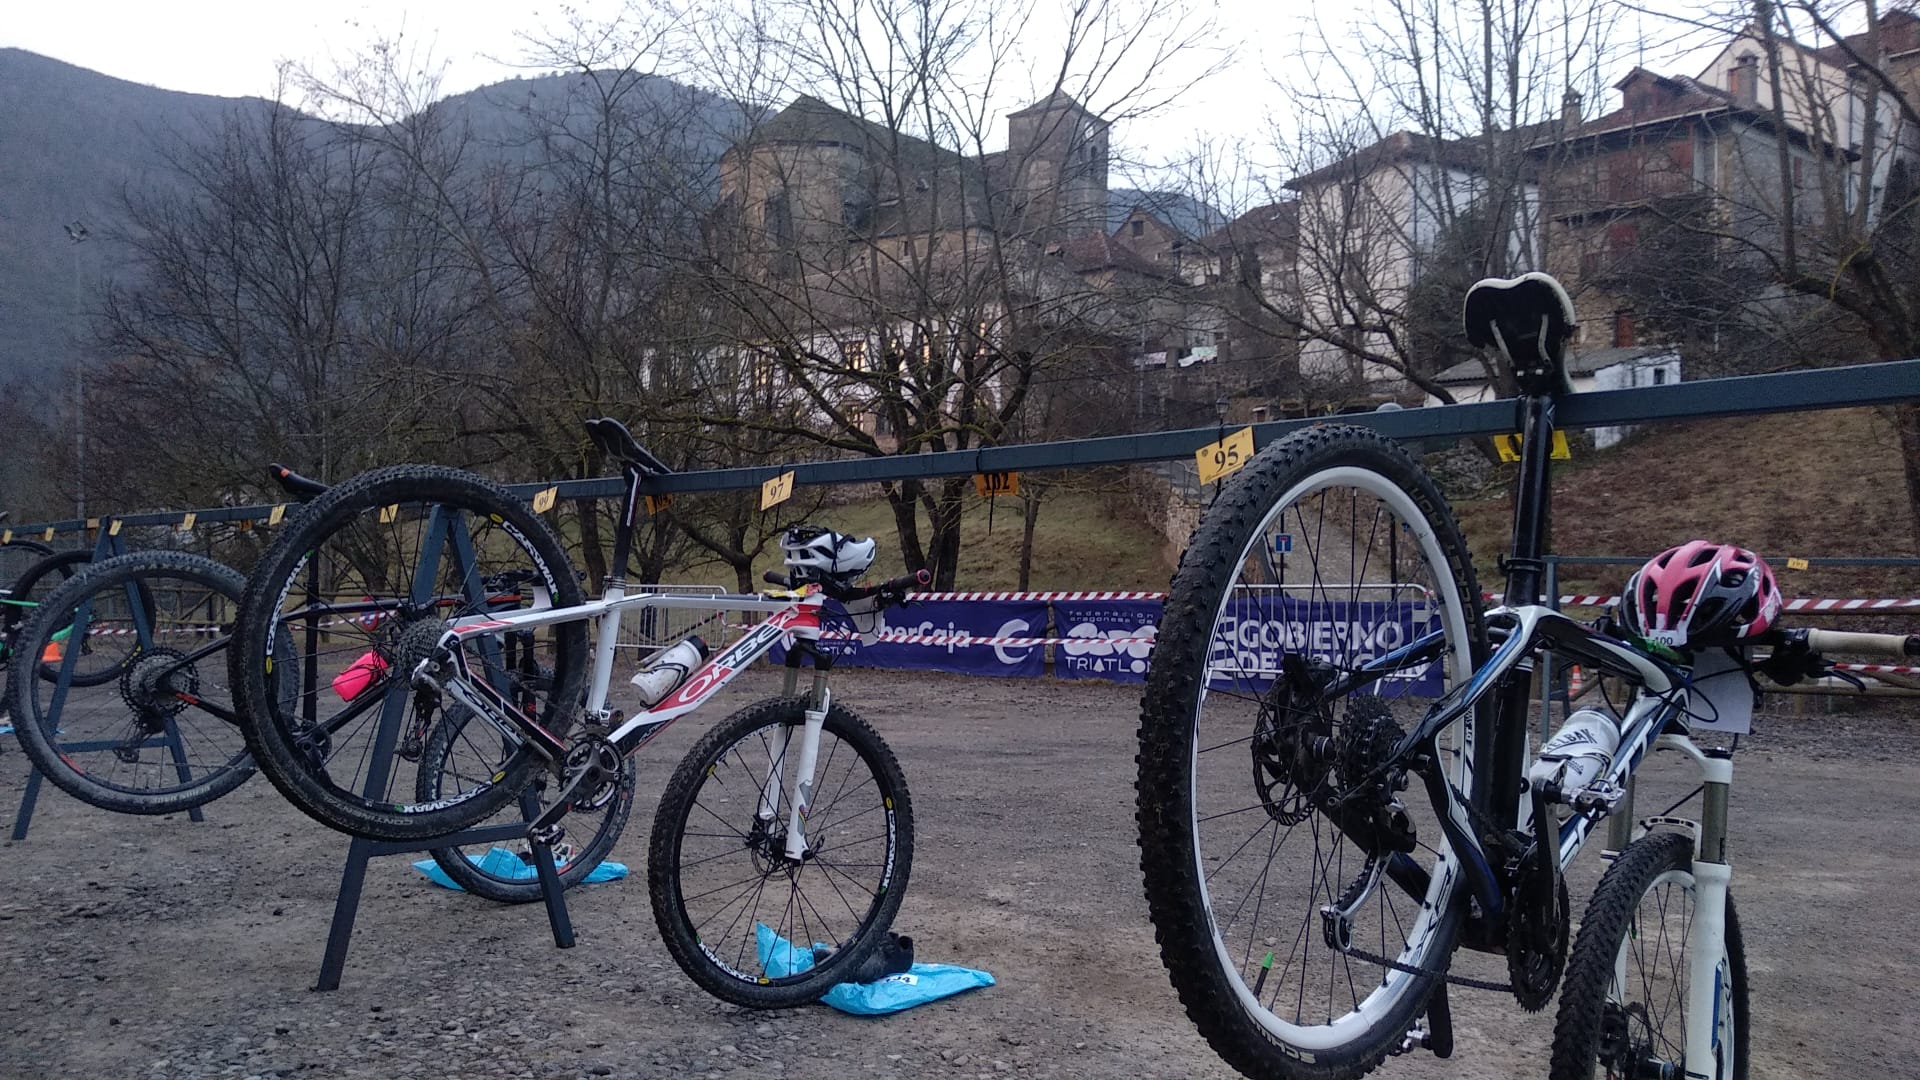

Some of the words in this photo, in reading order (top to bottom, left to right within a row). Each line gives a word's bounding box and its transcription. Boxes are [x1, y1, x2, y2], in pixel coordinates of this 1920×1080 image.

[1215, 444, 1239, 473] 95
[770, 482, 784, 501] 97
[880, 617, 970, 654] berCaja
[1238, 620, 1405, 651] GOBIERNO
